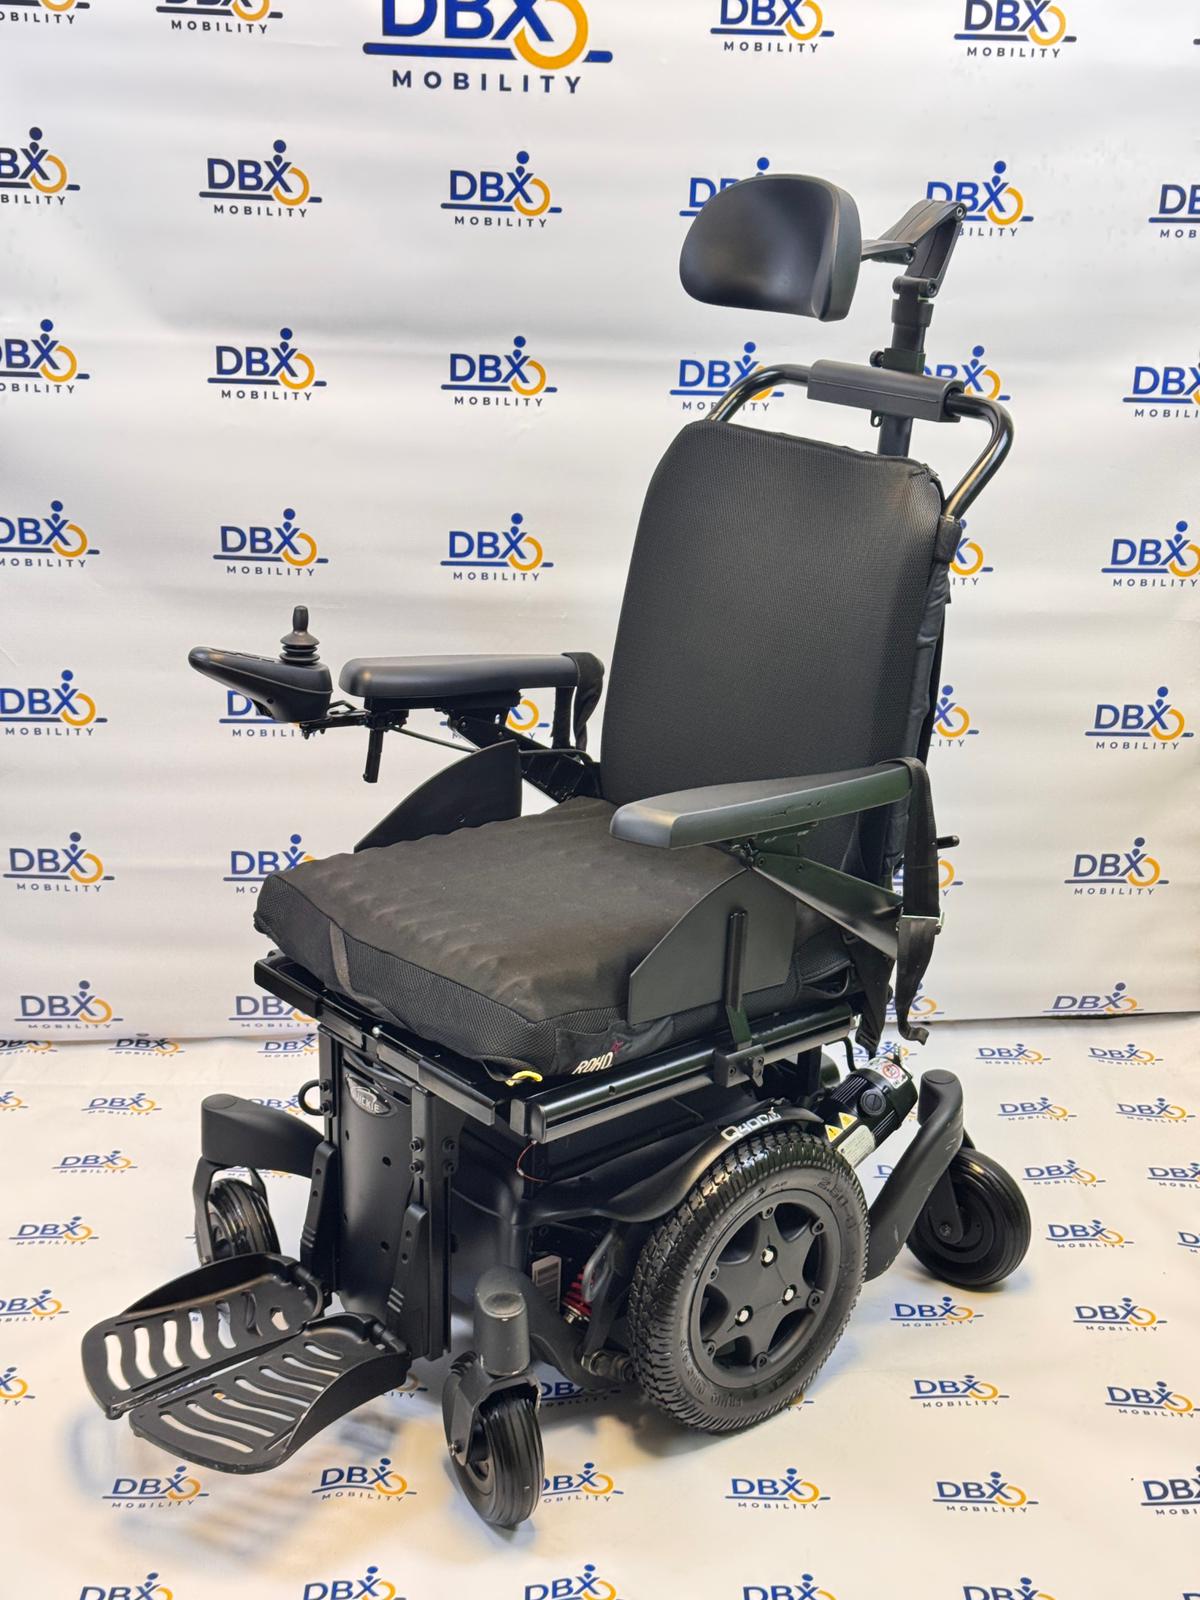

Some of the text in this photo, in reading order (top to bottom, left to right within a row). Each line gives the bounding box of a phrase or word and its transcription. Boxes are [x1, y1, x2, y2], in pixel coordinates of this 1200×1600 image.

[0, 11, 75, 24] OBILITY
[721, 0, 806, 26] DBX
[965, 0, 1050, 32] DBX
[171, 20, 267, 34] MOBILITY
[382, 0, 554, 42] DBX
[724, 41, 818, 53] MOBILITY
[967, 46, 1060, 58] MOBILITY
[391, 69, 581, 94] MOBILITY
[0, 147, 51, 181] BX
[207, 158, 293, 193] DBX
[450, 169, 534, 204] DBX
[0, 194, 65, 205] BILITY
[1160, 184, 1200, 215] DB
[214, 204, 307, 218] MOBILITY
[455, 216, 547, 228] MOBILITY
[957, 227, 1018, 238] BILITY
[0, 338, 61, 371] BX
[217, 345, 298, 378] DBX
[450, 353, 531, 384] DBX
[0, 382, 75, 394] OBILITY
[221, 389, 312, 401] MOBILITY
[454, 396, 543, 407] MOBILITY
[682, 401, 770, 411] MOITY
[1134, 408, 1200, 418] MOBILI
[221, 526, 300, 555] DBX
[449, 531, 527, 559] DBX
[1111, 539, 1190, 566] DBX
[227, 565, 314, 577] MOBILITY
[453, 571, 540, 581] MOBILITY
[1113, 578, 1198, 588] MOBILITY
[0, 688, 79, 716] DBX
[1094, 704, 1170, 729] DBX
[5, 727, 94, 736] MOBILITY
[1096, 741, 1179, 750] MOBILITY
[10, 848, 87, 874] DBX
[1073, 853, 1148, 877] DBX
[16, 883, 102, 893] MOBILITY
[1074, 887, 1154, 895] MOBILITY
[21, 994, 97, 1018] DBX
[1053, 995, 1128, 1010] DBX
[116, 1038, 173, 1051] DBX
[264, 1039, 317, 1051] DBX
[979, 1047, 1032, 1059] DBX
[1090, 1047, 1144, 1060] DBX
[91, 1097, 147, 1108] DBX
[1000, 1103, 1056, 1115] DBX
[1117, 1103, 1173, 1116] DBX
[62, 1156, 125, 1168] DBX
[1025, 1165, 1083, 1179] DBX
[18, 1223, 83, 1237] DBX
[1048, 1224, 1111, 1239] DBX
[895, 1303, 961, 1318] DBX
[1075, 1305, 1144, 1320] DBX
[914, 1379, 984, 1394] DBX
[1107, 1387, 1180, 1406] DBX
[922, 1400, 999, 1408] MOBILITY
[1118, 1408, 1195, 1418] MOBILITY
[320, 1467, 394, 1488] DBX
[112, 1477, 187, 1496] DBX
[732, 1478, 804, 1496] DBX
[937, 1481, 1012, 1499] DBX
[321, 1492, 406, 1501] MOBILITY
[544, 1495, 610, 1503] OBILITY
[111, 1500, 194, 1508] MOBILITY
[1155, 1508, 1198, 1516] MOBI
[81, 1584, 160, 1600] DBX
[304, 1579, 381, 1600] DBX
[525, 1577, 605, 1600] DBX
[743, 1584, 819, 1600] DBX
